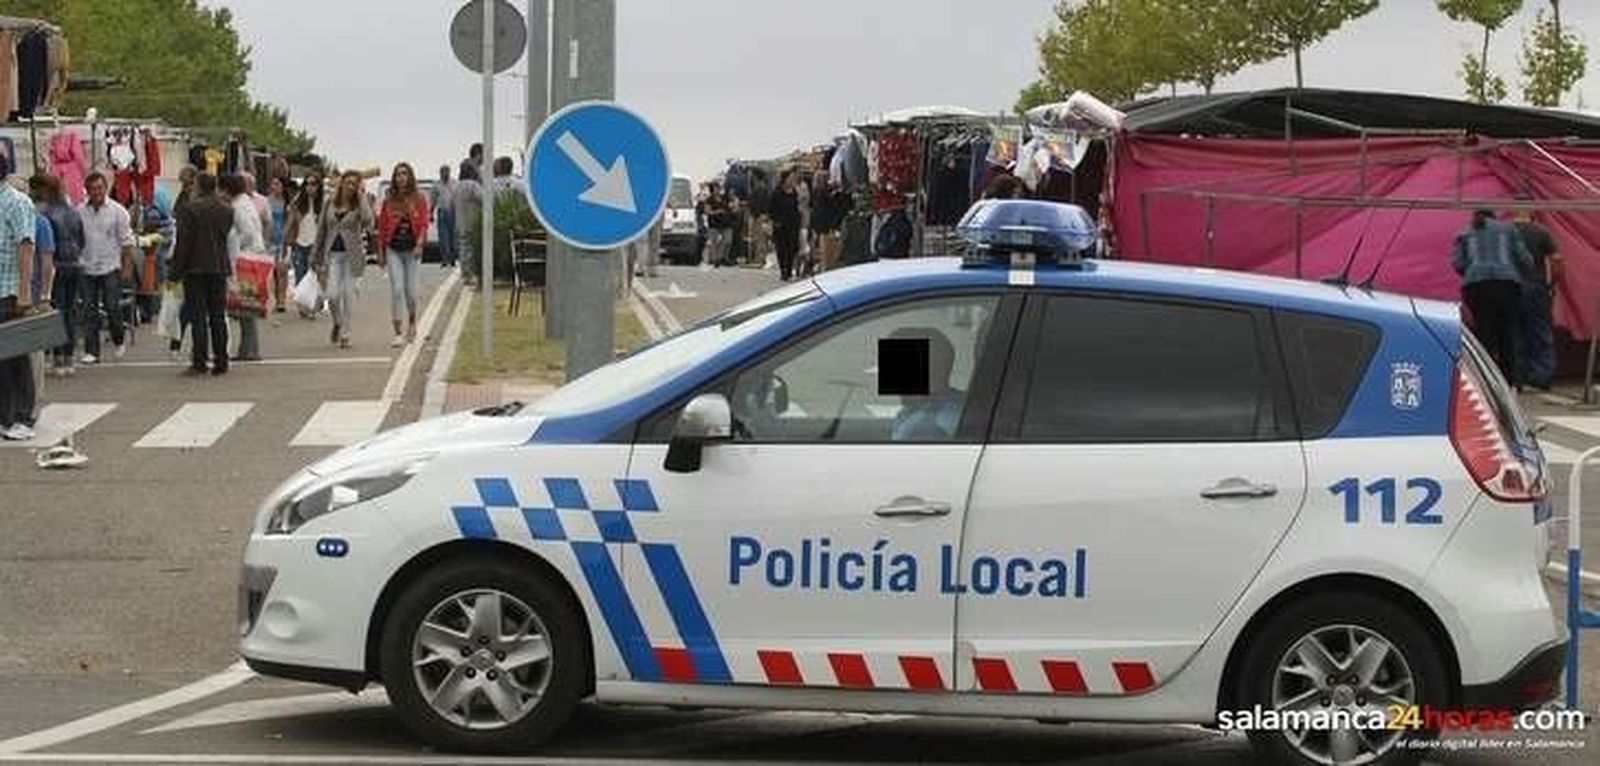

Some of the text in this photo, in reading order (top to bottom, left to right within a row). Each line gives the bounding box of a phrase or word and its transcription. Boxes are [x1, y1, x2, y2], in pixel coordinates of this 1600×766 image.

[1328, 477, 1443, 524] 112
[728, 535, 1087, 598] Policía Local
